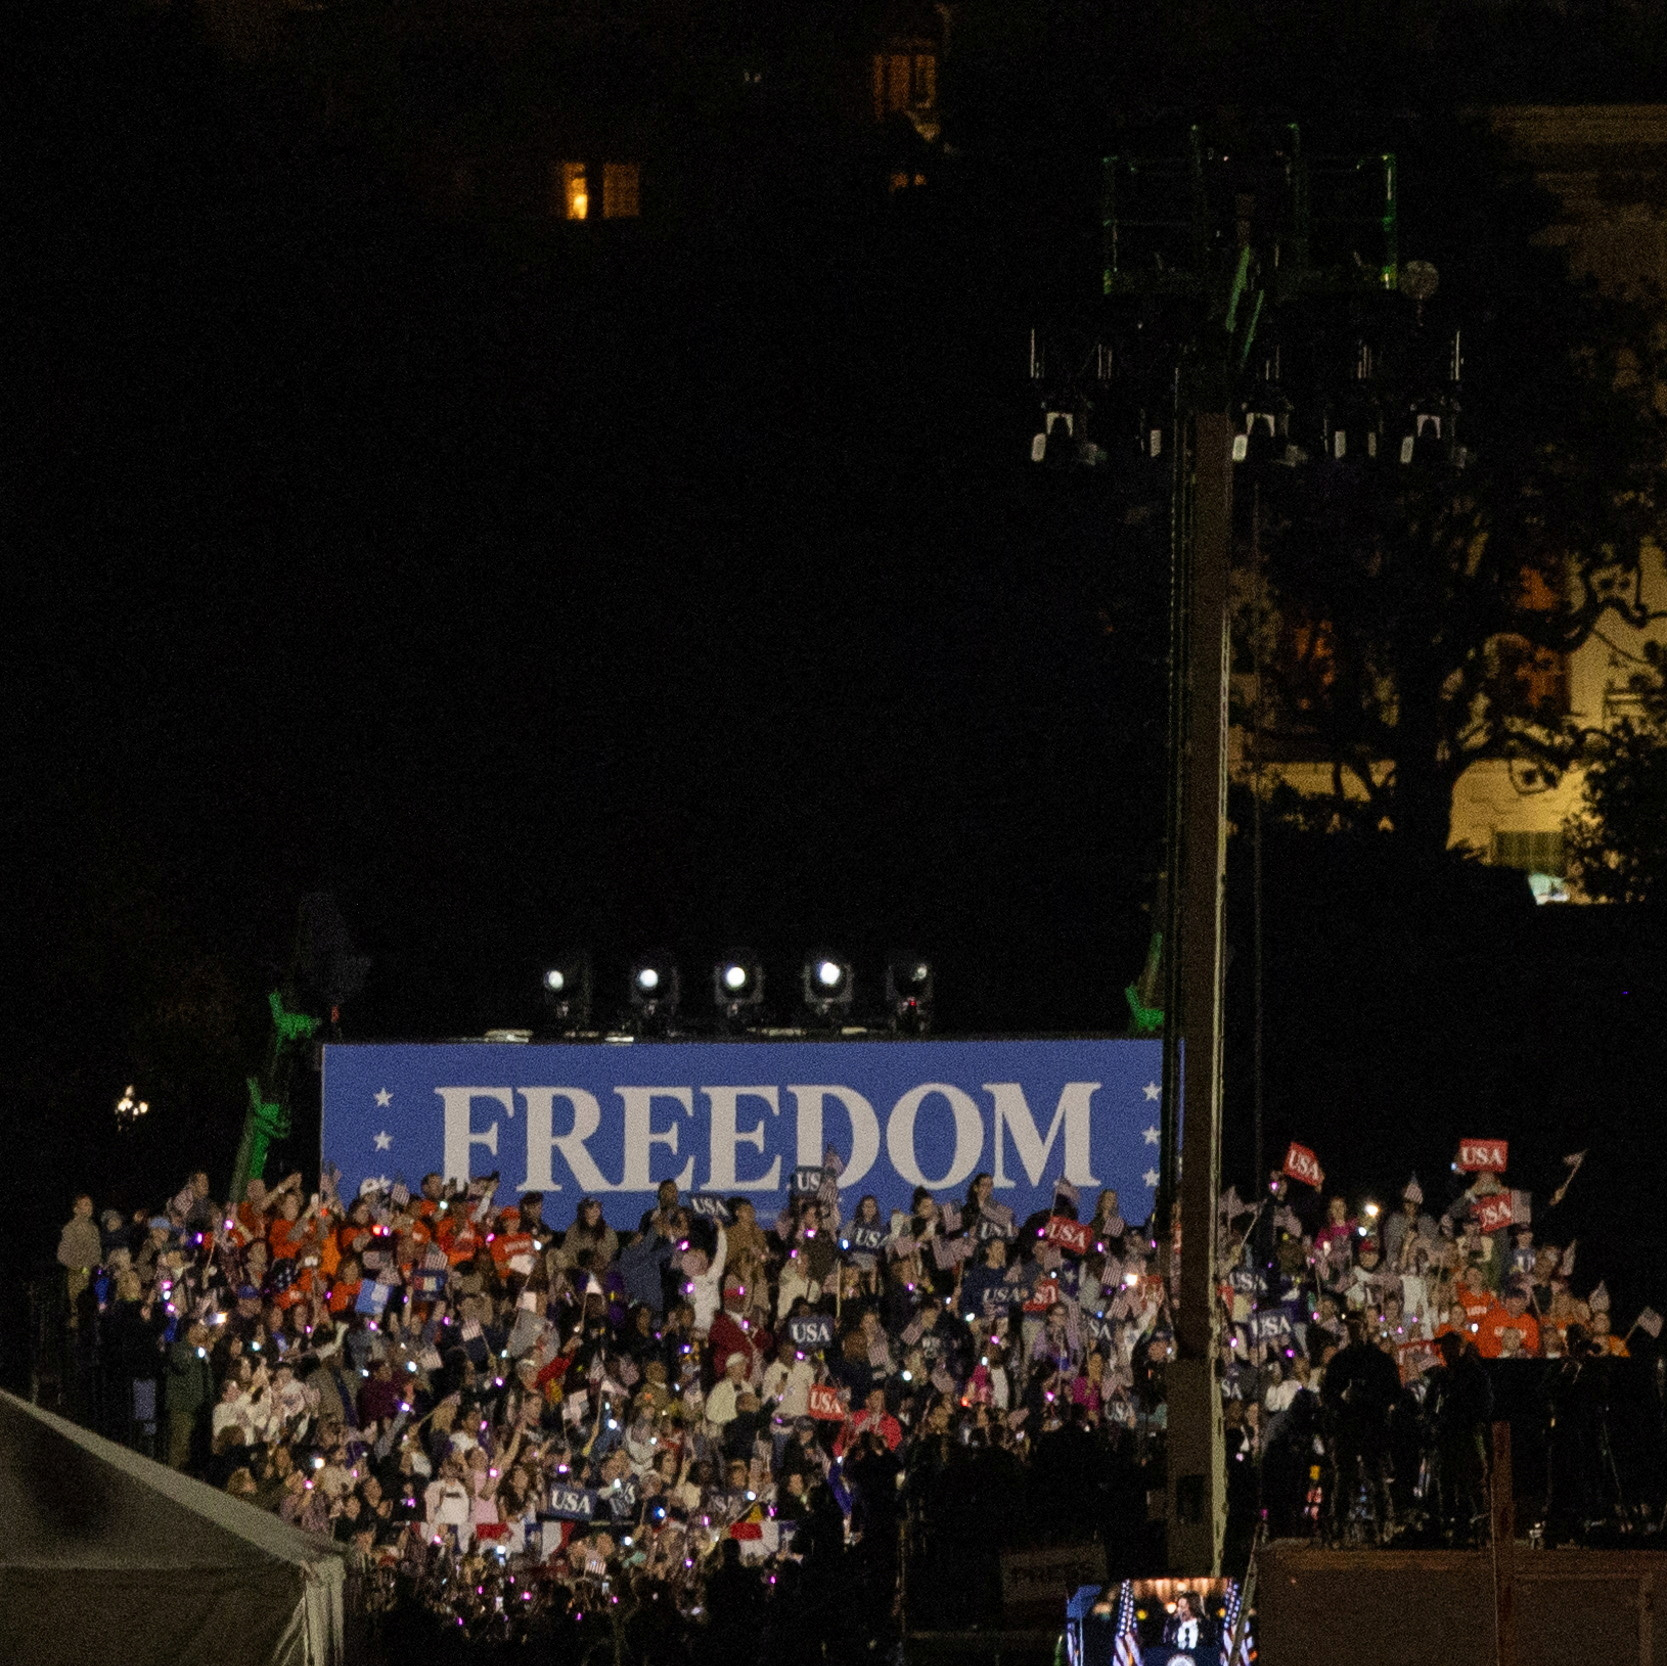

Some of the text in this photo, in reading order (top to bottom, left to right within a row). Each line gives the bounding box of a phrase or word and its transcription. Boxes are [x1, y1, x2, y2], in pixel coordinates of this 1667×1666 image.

[434, 1083, 1102, 1192] FREEDOM
[1289, 1154, 1319, 1177] USA
[1461, 1147, 1503, 1165] USA
[797, 1172, 821, 1191] US
[692, 1199, 729, 1217] USA
[1051, 1221, 1085, 1249] USA
[791, 1323, 831, 1343] USA
[810, 1391, 842, 1415] USA
[551, 1490, 591, 1514] USA
